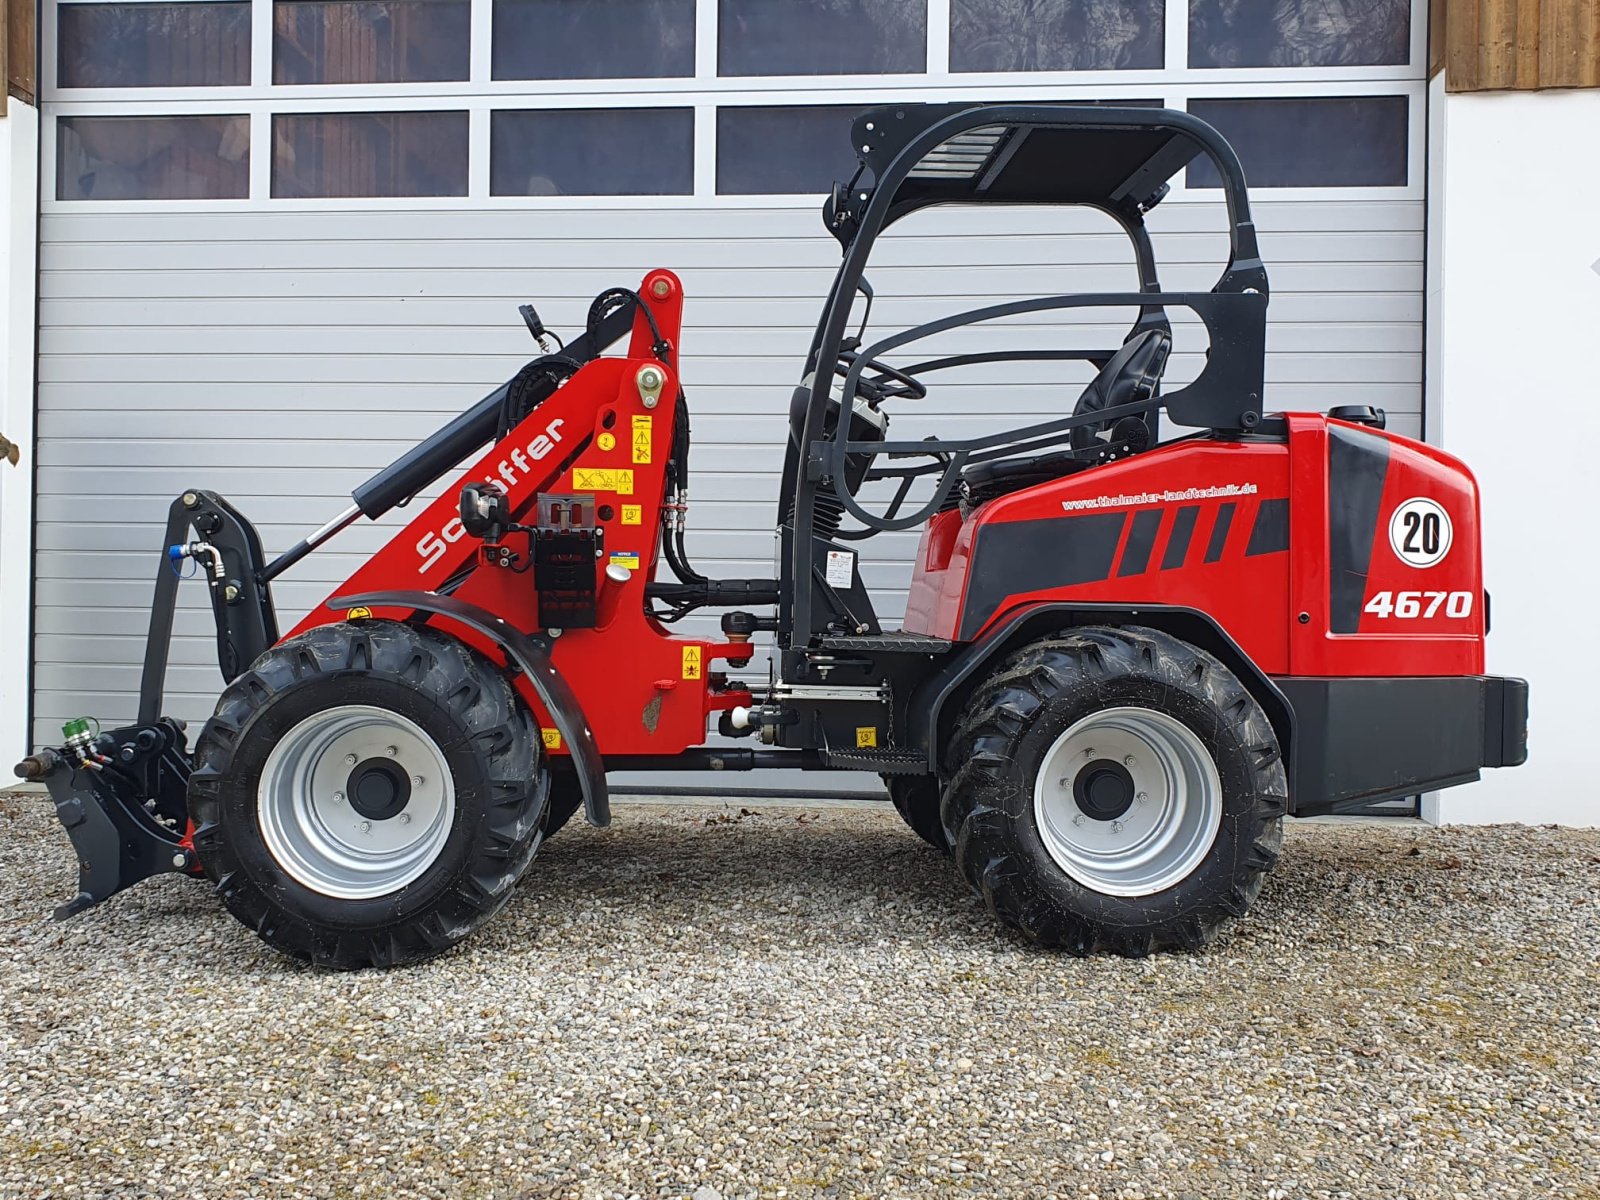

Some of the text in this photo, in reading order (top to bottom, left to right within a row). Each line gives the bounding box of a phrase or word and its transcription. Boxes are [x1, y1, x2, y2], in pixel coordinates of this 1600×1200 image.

[416, 418, 565, 575] Scffer
[1061, 483, 1258, 511] www.thalmaier-landtechnik.de
[1403, 511, 1440, 555] 20
[1364, 591, 1473, 619] 4670
